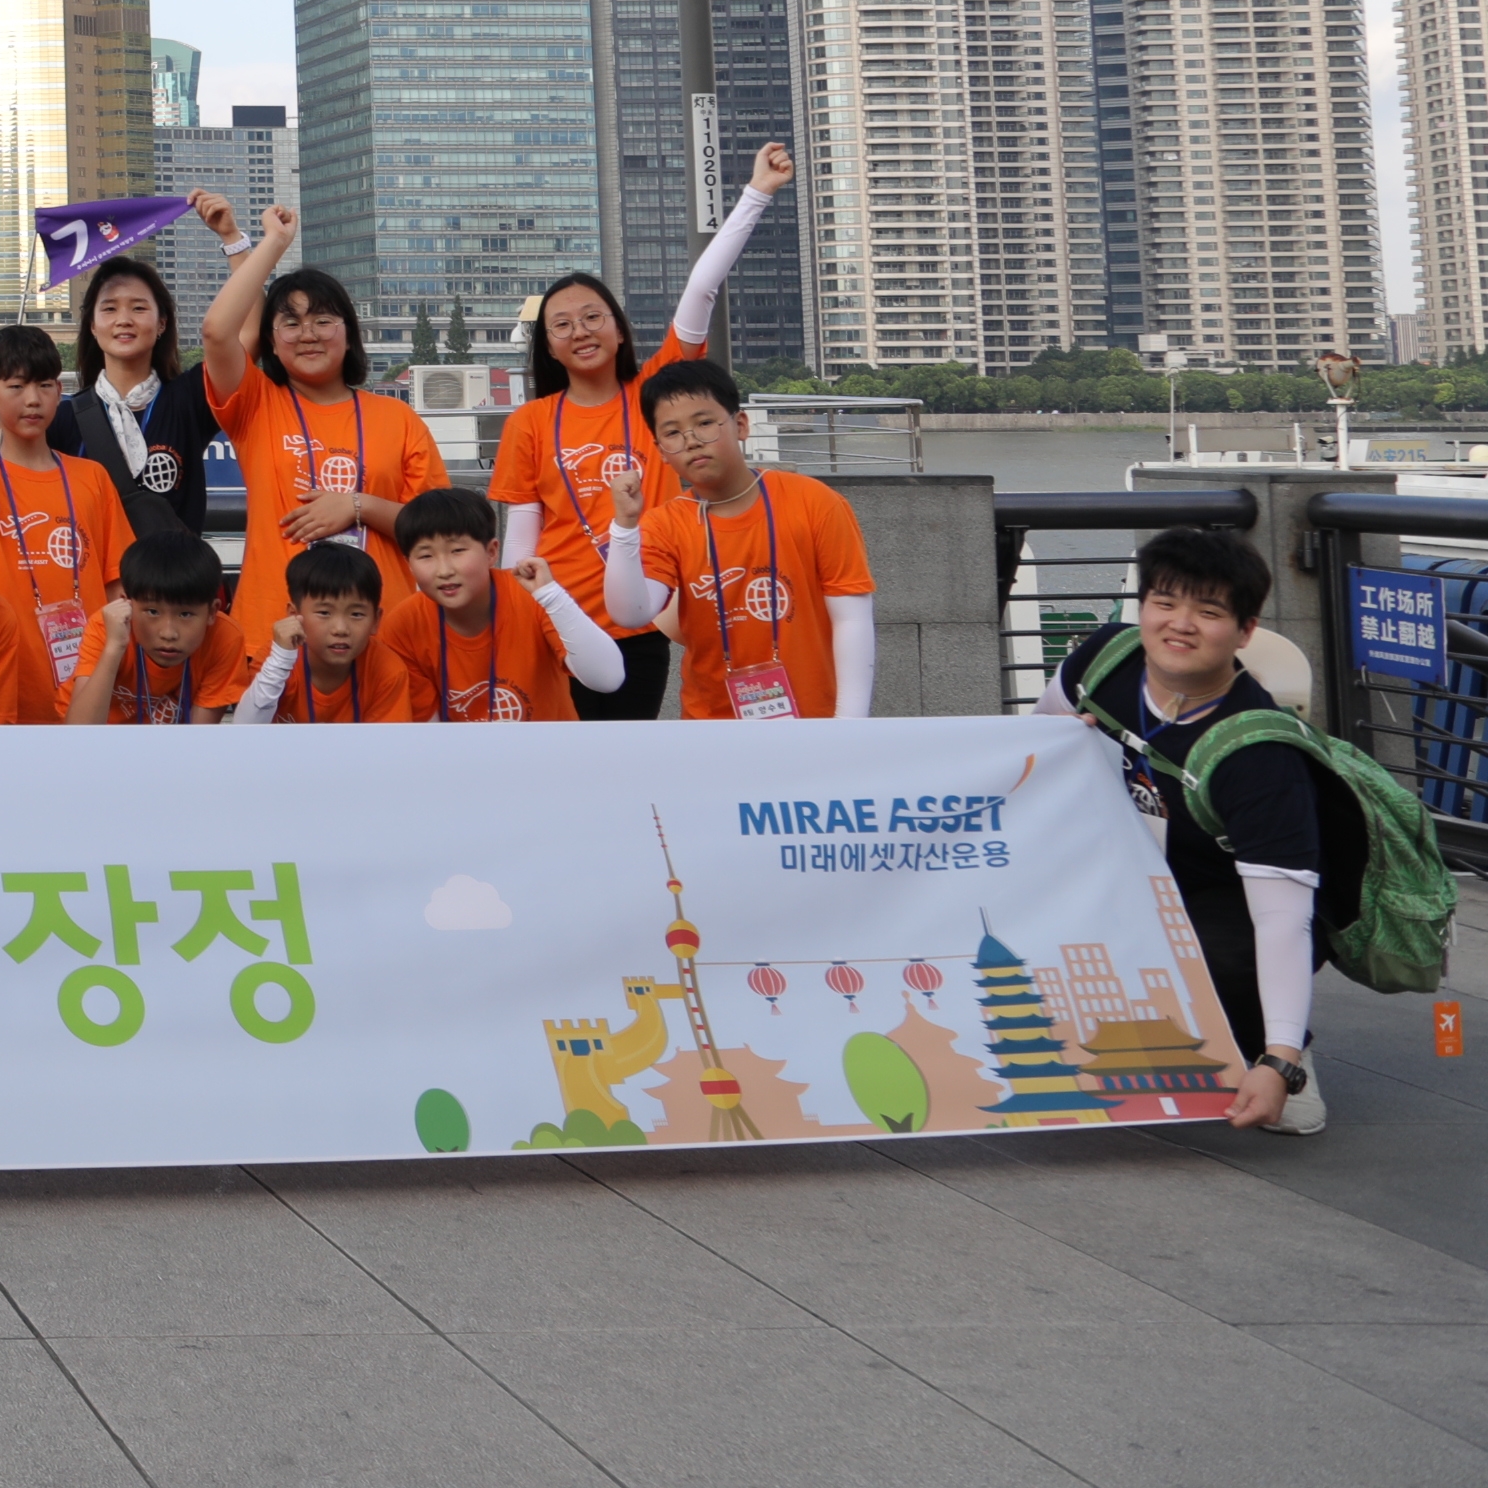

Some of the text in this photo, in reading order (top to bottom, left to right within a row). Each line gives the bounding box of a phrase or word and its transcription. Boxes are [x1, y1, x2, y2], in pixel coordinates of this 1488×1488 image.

[702, 117, 719, 230] 11020114
[50, 218, 89, 268] 7
[328, 446, 353, 456] Global
[1368, 448, 1427, 463] 公安215
[76, 522, 90, 554] Leader
[1359, 585, 1434, 618] 工作场所
[1360, 615, 1437, 650] 禁止翻越
[509, 681, 531, 706] Leader
[738, 794, 1006, 837] MIRAE ASSET
[779, 840, 1011, 874] 미래에셋자산운용
